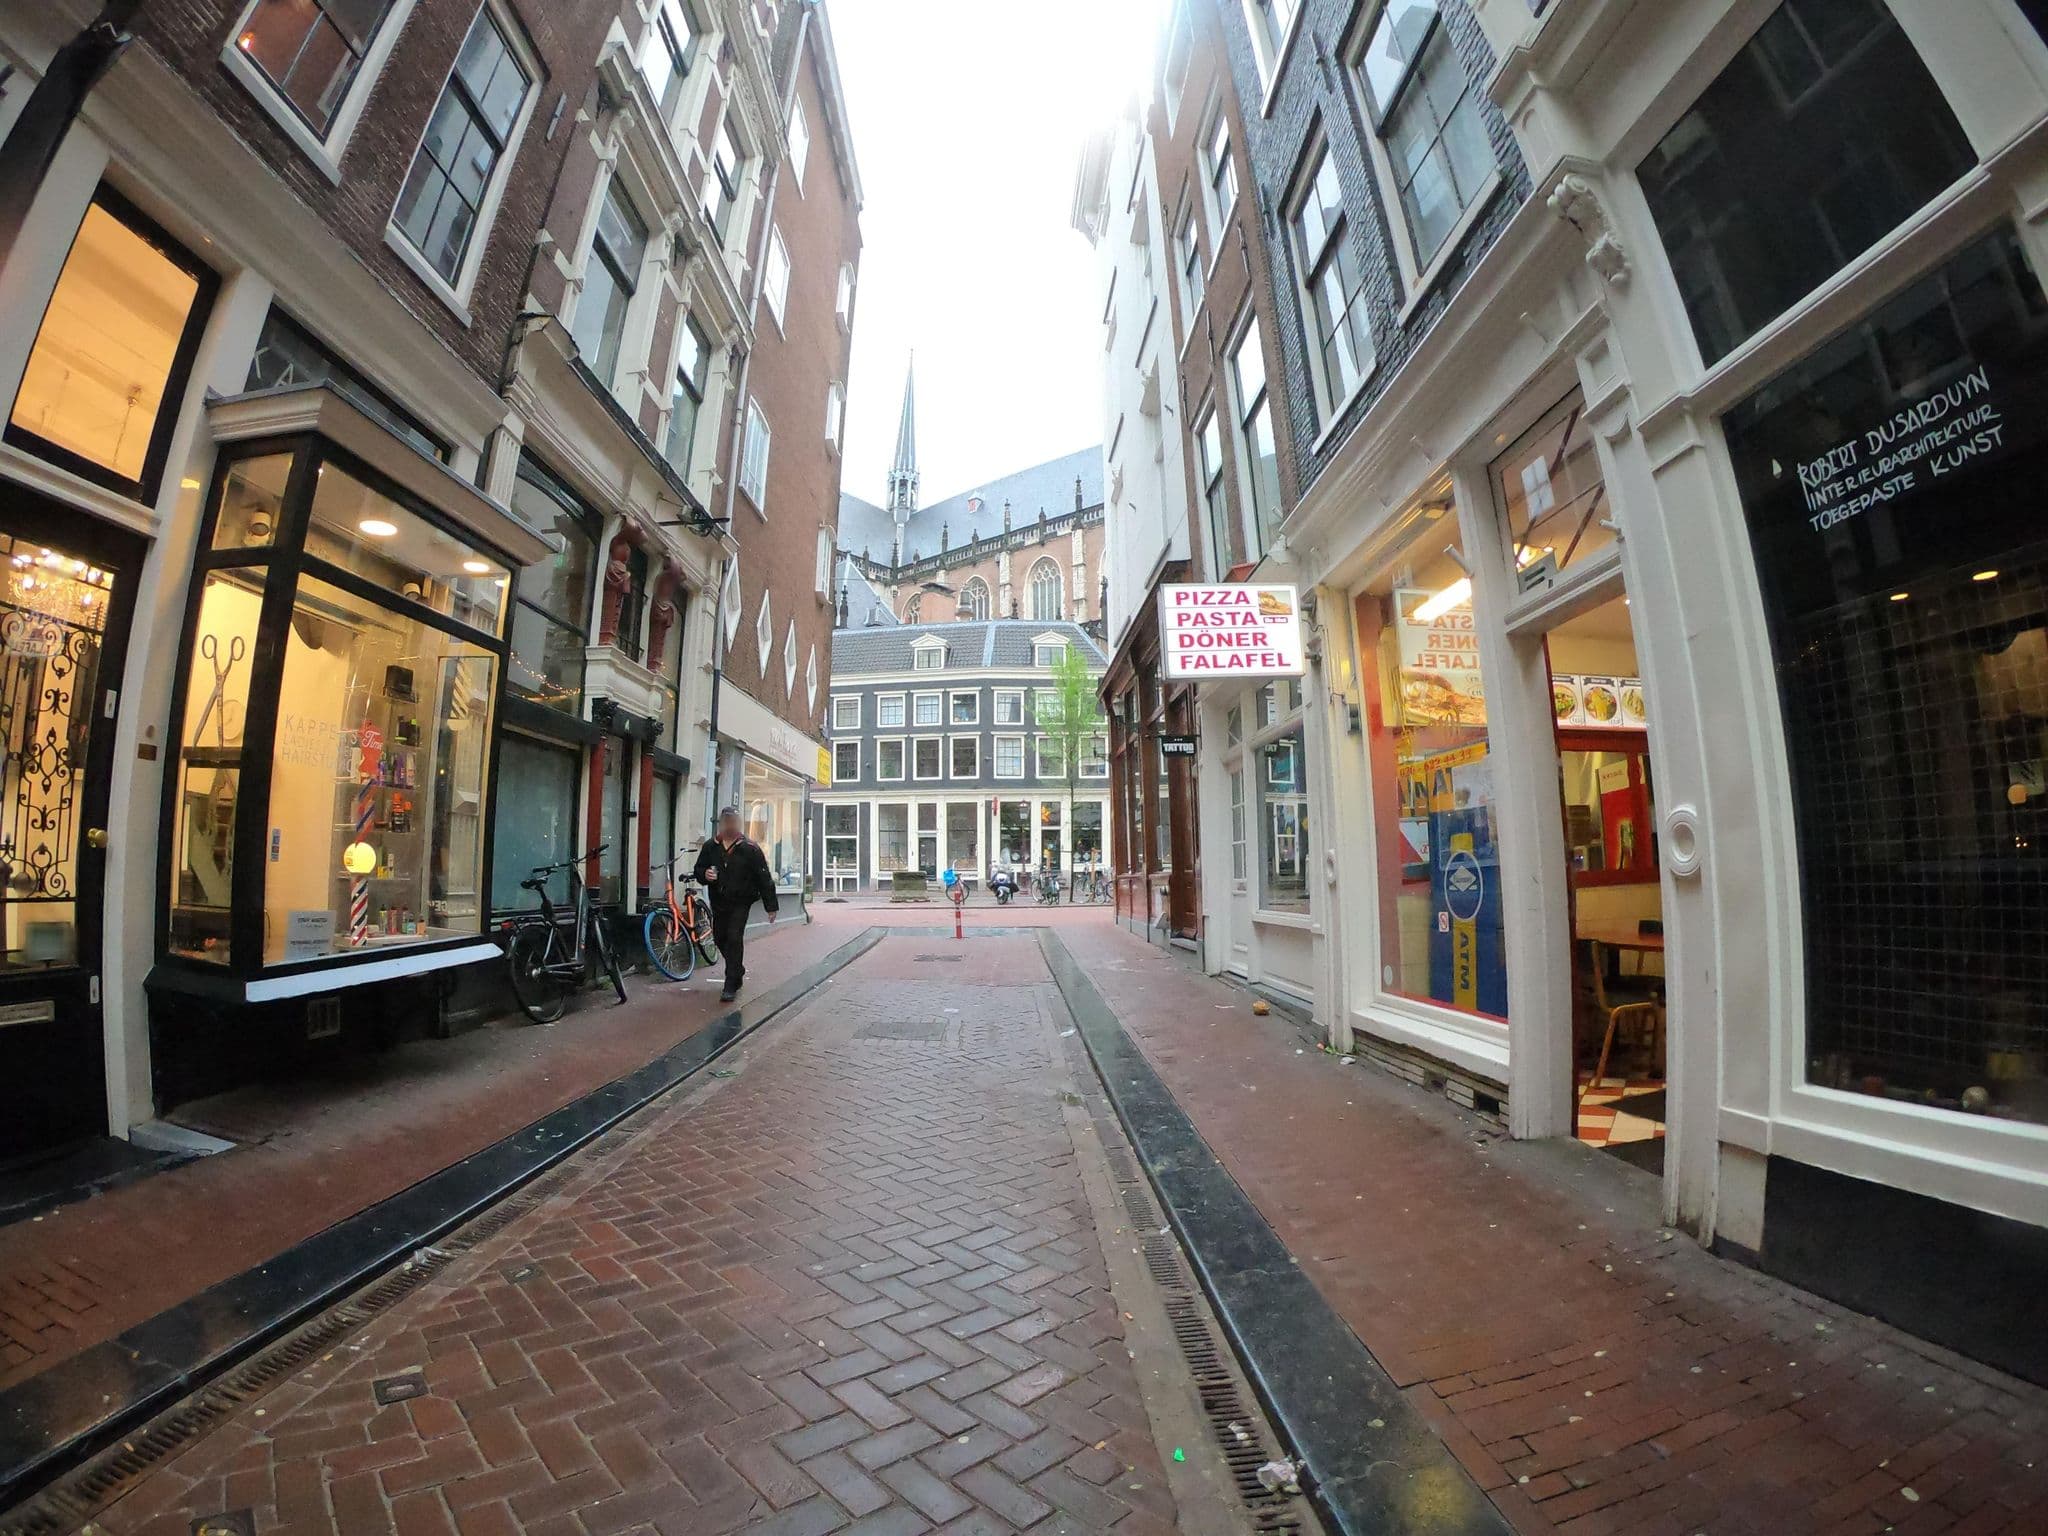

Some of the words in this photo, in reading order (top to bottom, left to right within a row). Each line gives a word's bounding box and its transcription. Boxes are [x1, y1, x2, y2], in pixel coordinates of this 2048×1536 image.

[1797, 440, 1858, 511] ROBERT
[1865, 364, 1990, 455] DUSARDUYN
[1810, 404, 2002, 511] INTERIEURARCHITEKTUUR
[1809, 472, 1916, 532] TOEGEPASTE
[1930, 424, 2003, 477] KUNST
[1175, 591, 1250, 606] PIZZA
[1177, 612, 1258, 627] PASTA
[1179, 629, 1268, 648] DÖNER
[1180, 652, 1291, 670] FALAFEL
[1460, 932, 1470, 990] ATM
